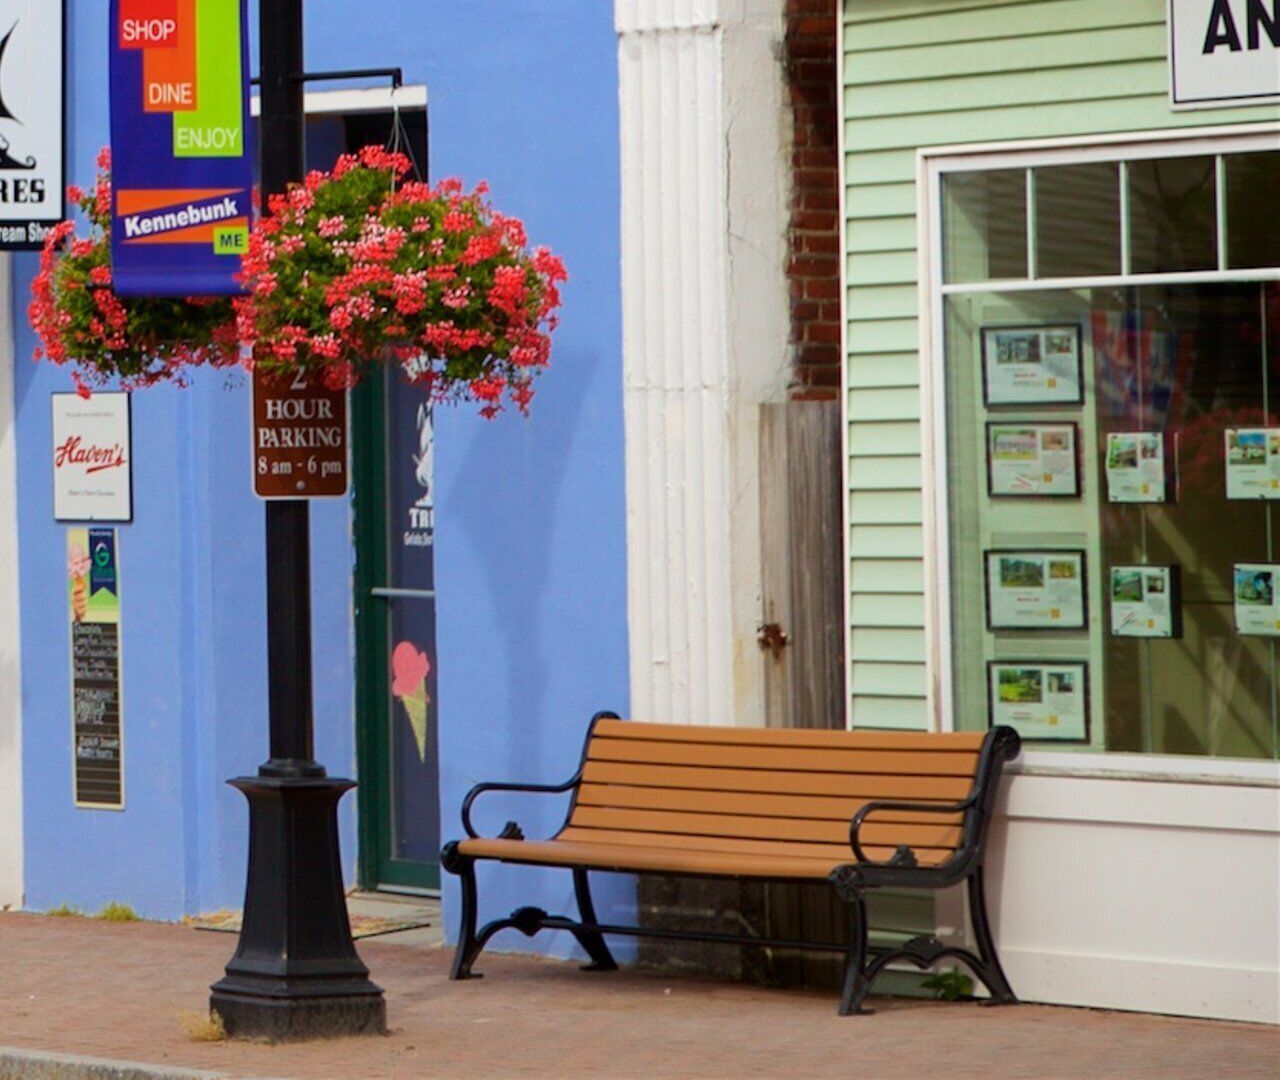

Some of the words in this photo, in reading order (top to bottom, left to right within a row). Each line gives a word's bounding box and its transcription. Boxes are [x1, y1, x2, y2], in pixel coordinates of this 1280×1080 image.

[122, 19, 176, 41] SHOP
[148, 82, 193, 105] DINE
[176, 127, 240, 149] ENJOY
[125, 197, 239, 238] Kennebunk
[219, 233, 244, 248] ME
[290, 365, 308, 390] 2
[265, 399, 333, 420] HOUR
[258, 427, 341, 448] PARKING
[258, 456, 268, 475] 8
[271, 460, 292, 475] am
[307, 455, 316, 474] 6
[321, 459, 342, 477] pm
